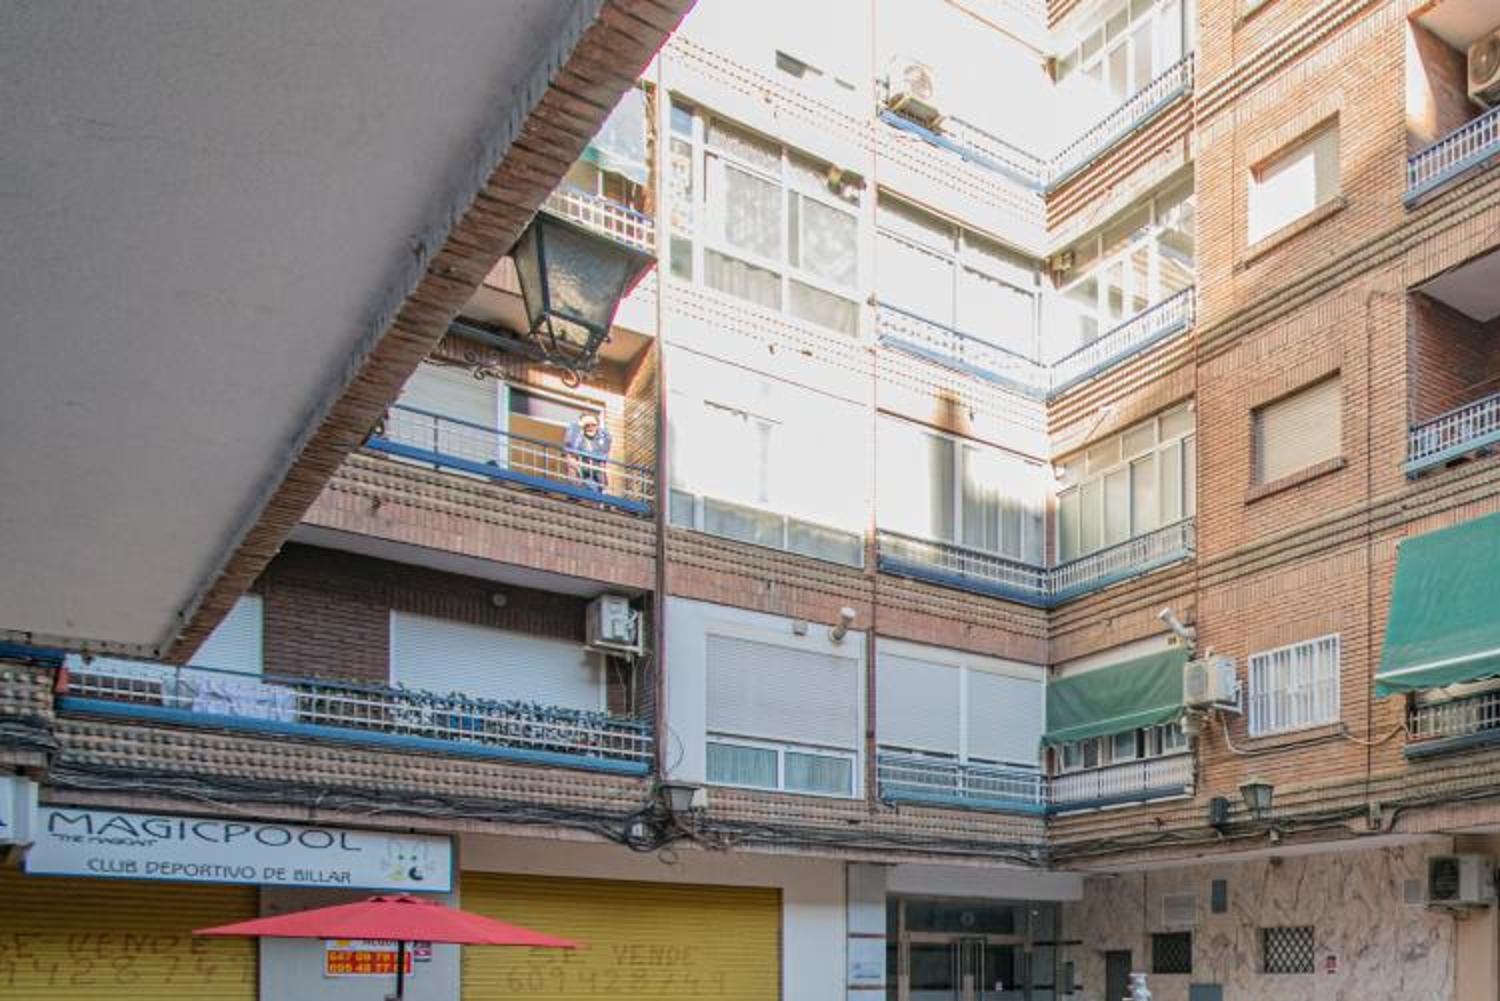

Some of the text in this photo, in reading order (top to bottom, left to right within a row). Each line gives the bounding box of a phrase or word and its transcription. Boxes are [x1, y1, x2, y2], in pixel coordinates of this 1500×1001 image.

[48, 811, 362, 851] MAGICPOOL
[87, 857, 351, 884] CLUB DEPORTIVO DE BILLAR
